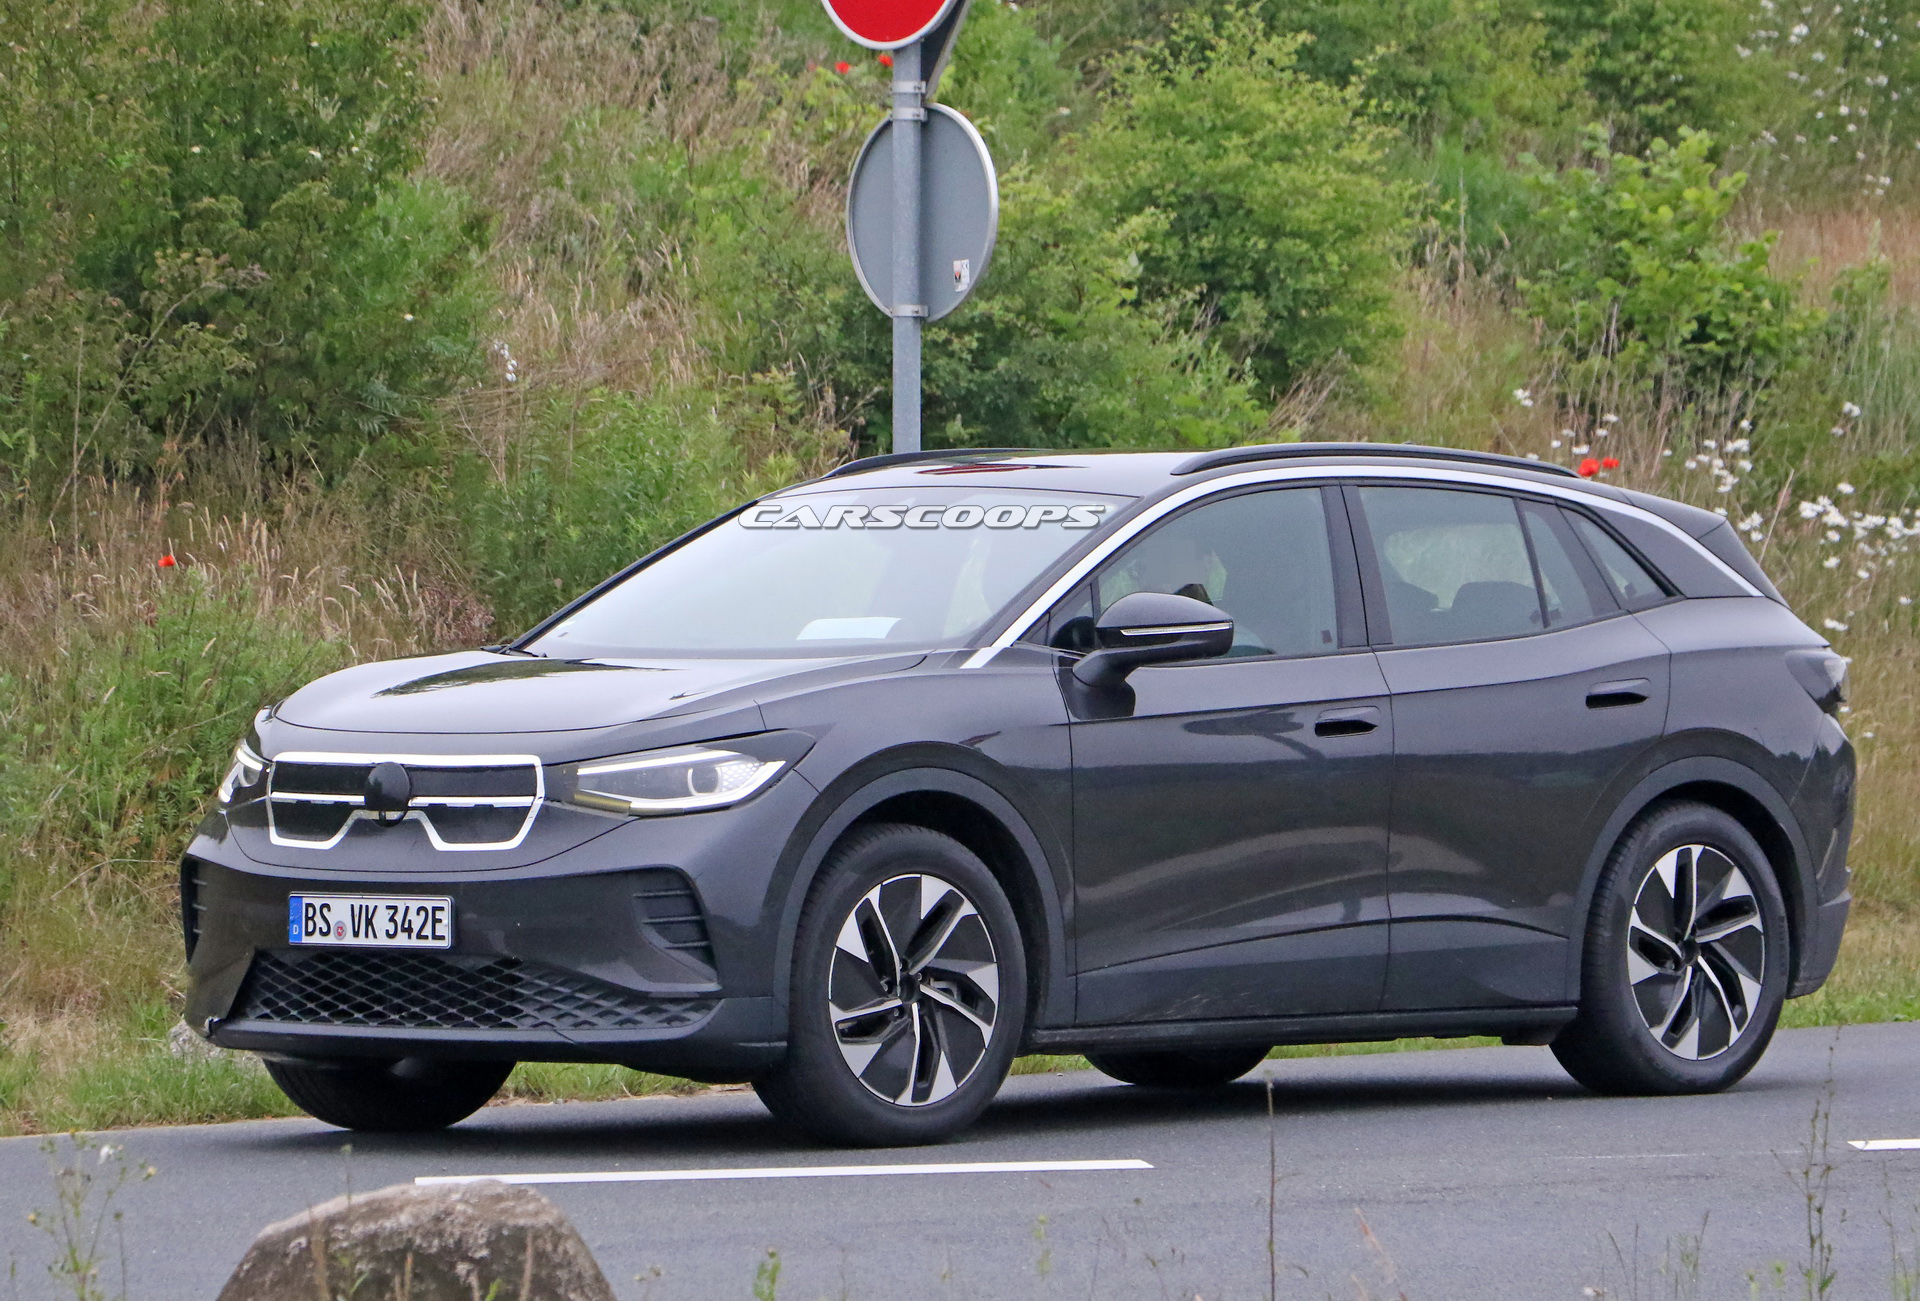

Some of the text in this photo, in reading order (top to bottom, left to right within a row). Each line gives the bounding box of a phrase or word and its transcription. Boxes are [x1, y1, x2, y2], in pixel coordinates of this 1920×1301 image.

[293, 925, 299, 934] D
[305, 903, 445, 940] BS VK 342E
